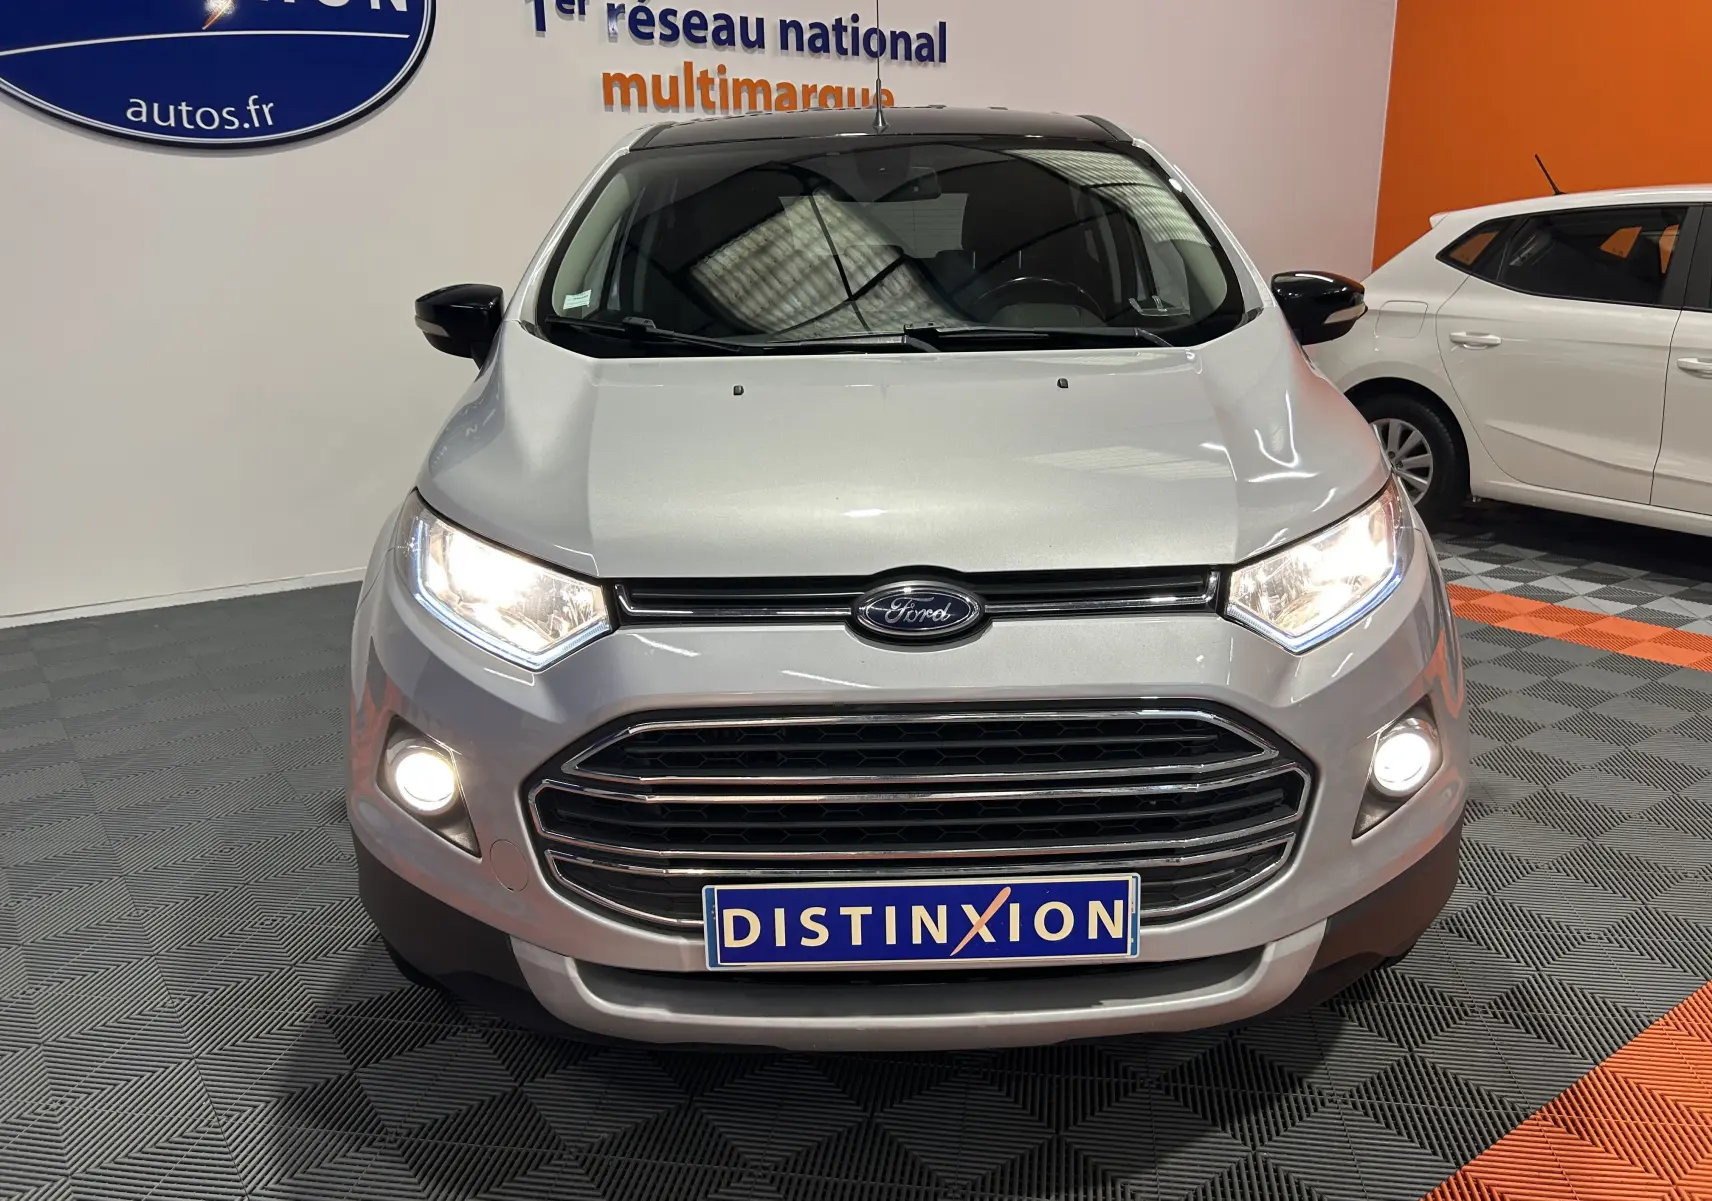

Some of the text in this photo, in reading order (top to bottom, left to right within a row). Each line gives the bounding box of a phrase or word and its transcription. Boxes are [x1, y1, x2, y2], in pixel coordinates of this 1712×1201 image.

[607, 0, 765, 50] réseau
[780, 13, 947, 63] national
[126, 95, 274, 130] autos.fr
[884, 596, 952, 624] Ford
[722, 886, 1124, 957] DISTINXION
